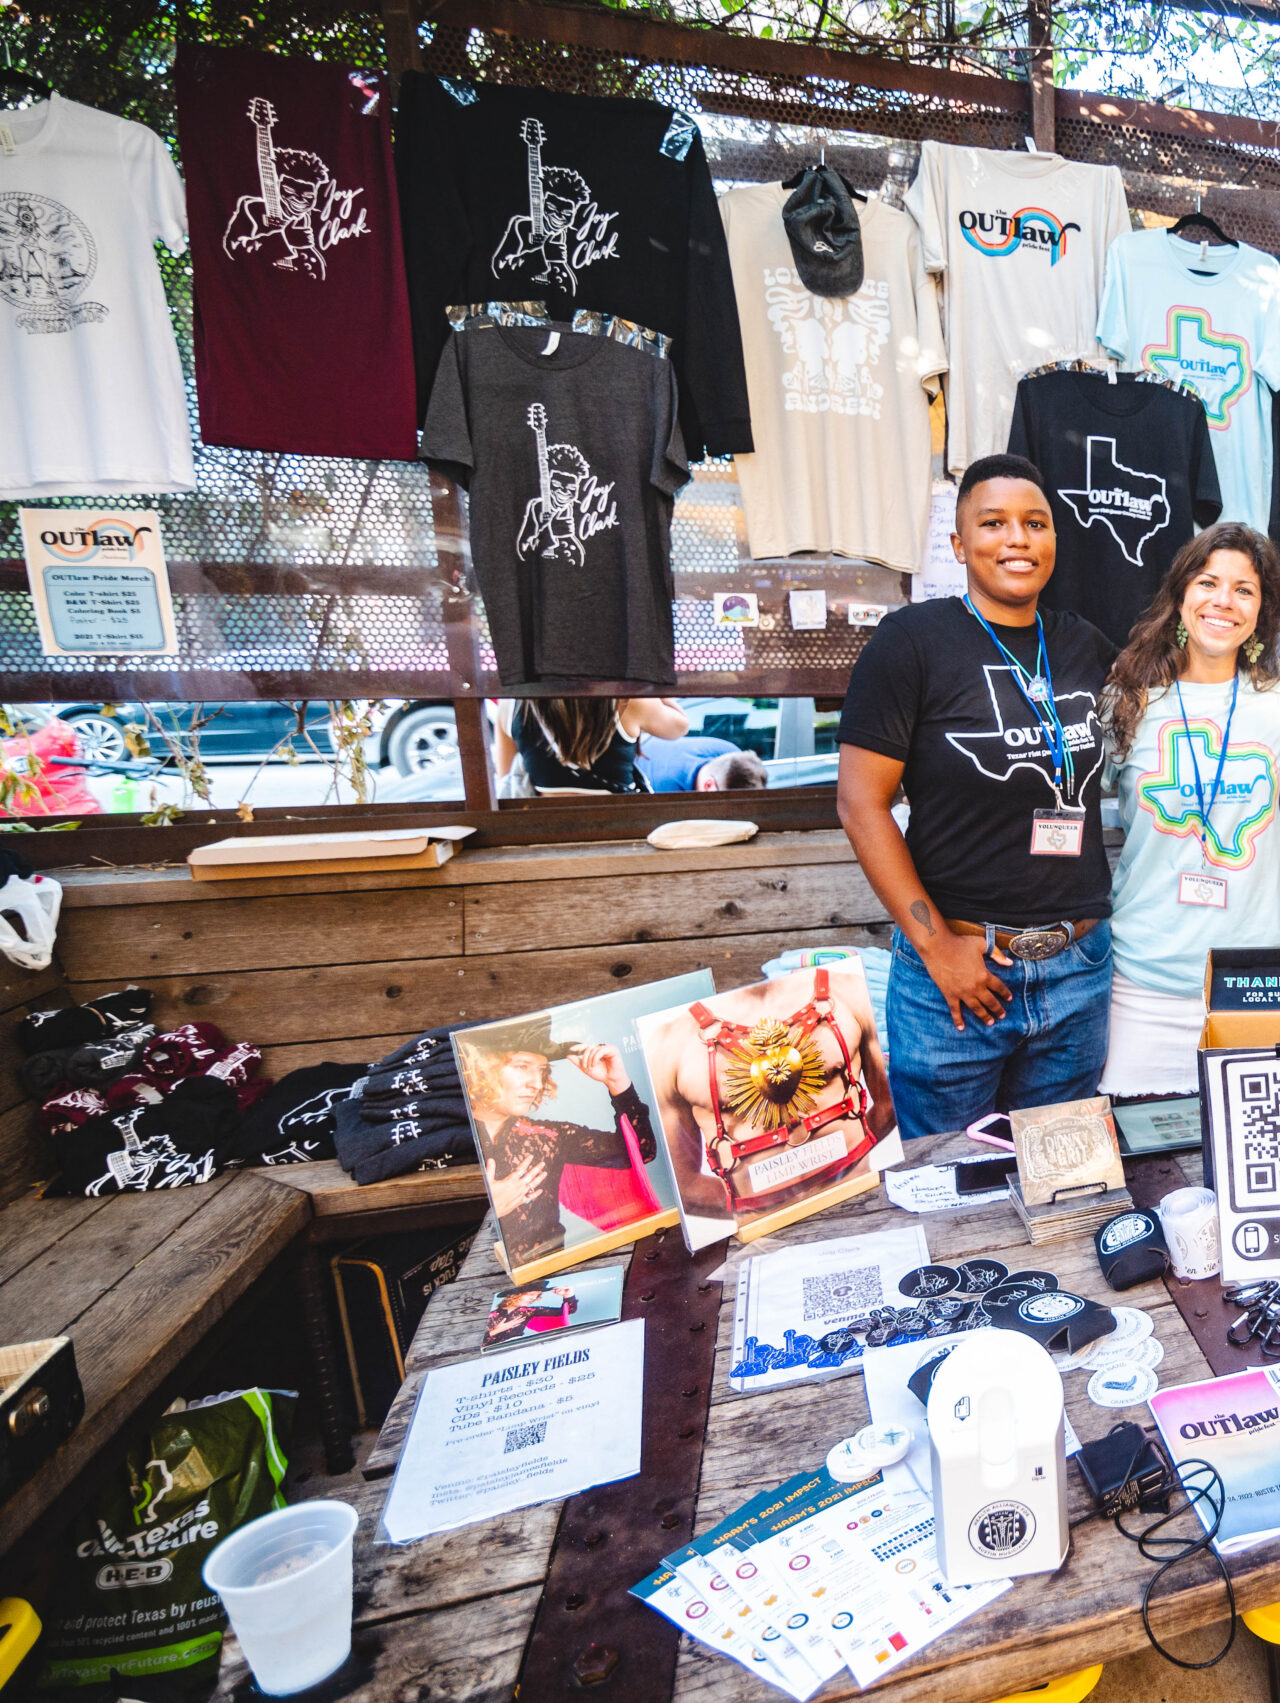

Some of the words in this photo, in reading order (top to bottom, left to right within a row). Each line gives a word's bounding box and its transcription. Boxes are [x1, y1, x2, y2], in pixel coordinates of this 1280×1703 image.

[321, 179, 364, 221] Joy
[319, 208, 371, 250] Clark
[576, 202, 619, 240] Joy
[959, 210, 1081, 246] OUTlaw
[572, 232, 620, 269] Clark
[580, 476, 615, 513] Joy
[40, 527, 152, 547] OUTlaw
[579, 501, 620, 541] Clark
[93, 574, 118, 582] Pride
[1003, 711, 1098, 747] OUTaw
[753, 1150, 801, 1176] PAISLEY
[797, 1151, 834, 1170] WRIST
[824, 1312, 866, 1325] venmo
[481, 1361, 541, 1388] PAISLEY
[543, 1348, 591, 1372] FIELDS
[454, 1399, 494, 1414] Vinyl
[499, 1383, 556, 1403] Records
[568, 1372, 596, 1384] $25
[456, 1386, 514, 1404] T-shirts
[525, 1374, 554, 1387] $30
[445, 1429, 494, 1446] Pre-order
[575, 1400, 600, 1412] vinyl
[449, 1419, 482, 1432] Tube
[486, 1403, 546, 1423] Bandana
[556, 1394, 573, 1405] $5
[451, 1411, 480, 1424] CDs
[493, 1399, 523, 1412] $10
[1180, 1407, 1279, 1440] OUTlaw
[1248, 1427, 1264, 1436] pride
[713, 1517, 758, 1545] HAAM'S
[759, 1501, 784, 1519] 2021
[785, 1477, 822, 1503] IMPACT
[771, 1505, 816, 1532] HAAM'S
[818, 1489, 843, 1508] 2021
[844, 1473, 882, 1495] IMPACT
[1255, 1488, 1276, 1498] RUSTIC
[126, 1500, 211, 1548] Texas
[974, 1509, 990, 1525] HEALTH
[992, 1502, 1019, 1511] ALLIANCE
[1020, 1507, 1030, 1517] FOR
[977, 1545, 997, 1557] AUSTIN
[999, 1538, 1029, 1557] MUSICIANS
[84, 1613, 127, 1631] protect
[131, 1607, 166, 1624] Texas
[171, 1602, 188, 1616] by
[126, 1629, 157, 1642] content
[159, 1625, 175, 1636] and
[177, 1619, 197, 1631] 100%
